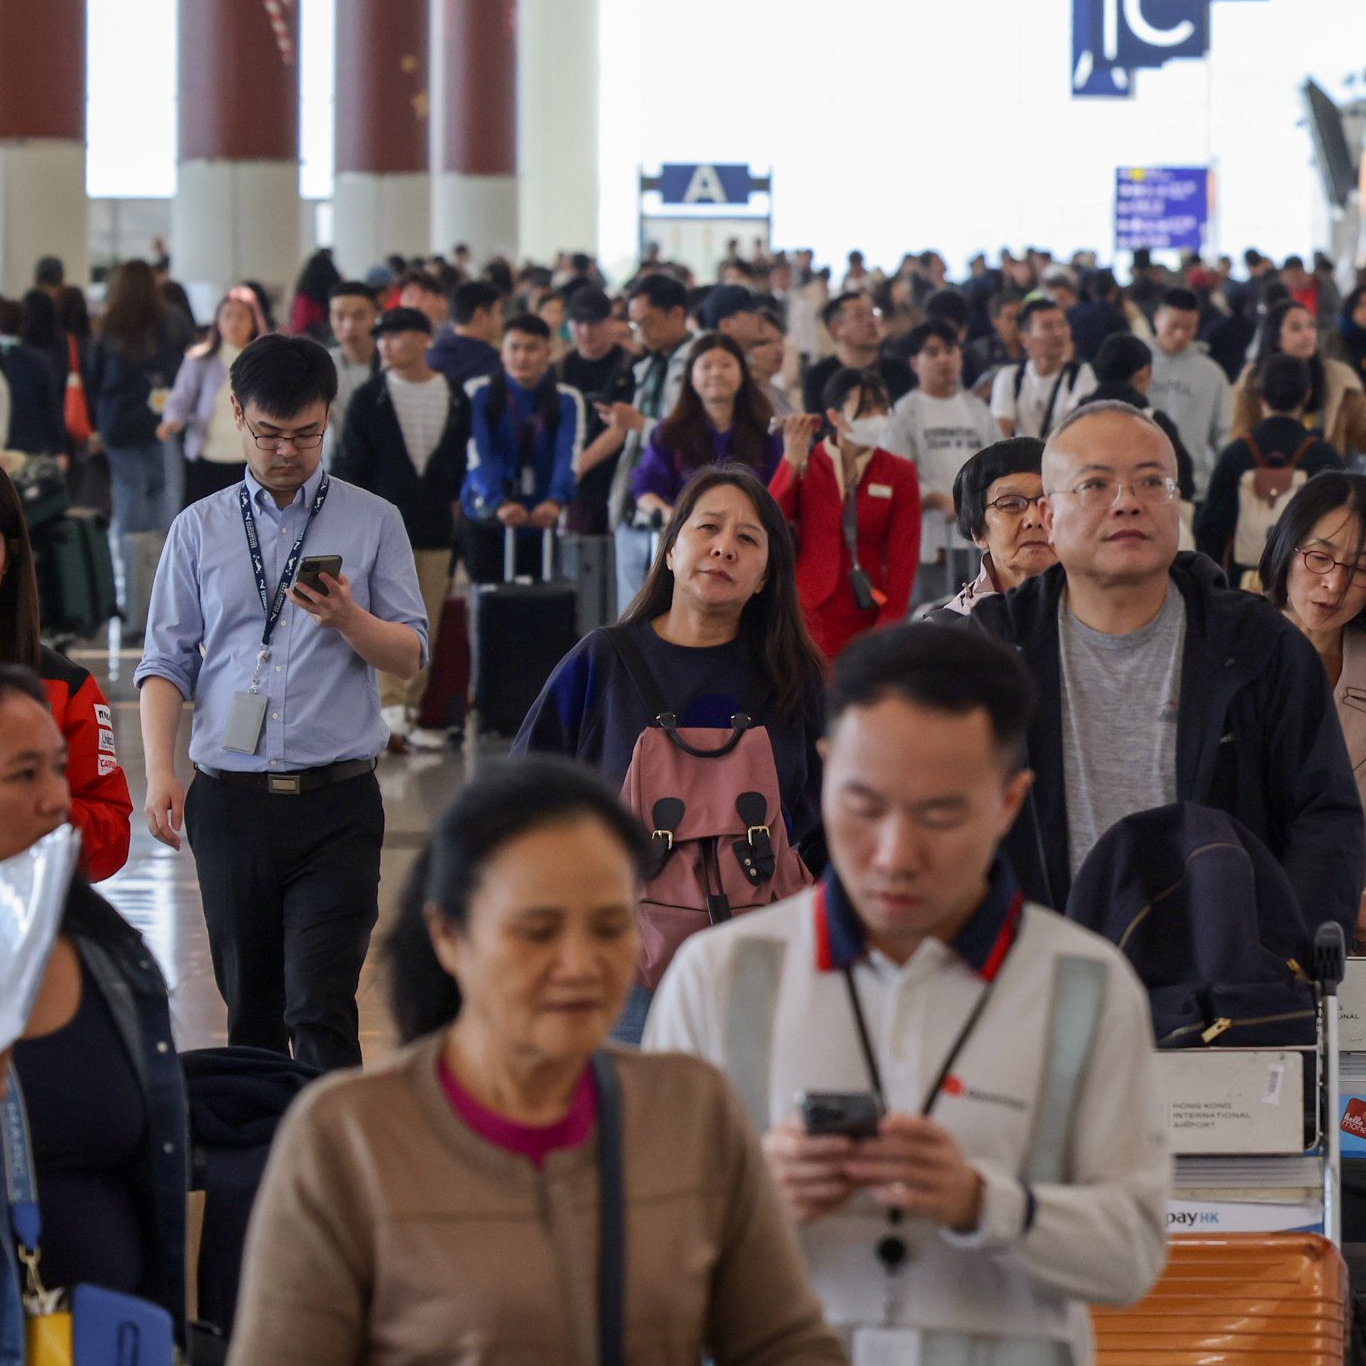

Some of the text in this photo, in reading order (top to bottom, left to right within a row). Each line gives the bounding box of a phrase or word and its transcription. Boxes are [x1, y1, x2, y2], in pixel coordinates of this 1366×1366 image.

[683, 165, 729, 203] A
[1173, 1102, 1232, 1110] HONG KONG
[1343, 1112, 1364, 1126] hello
